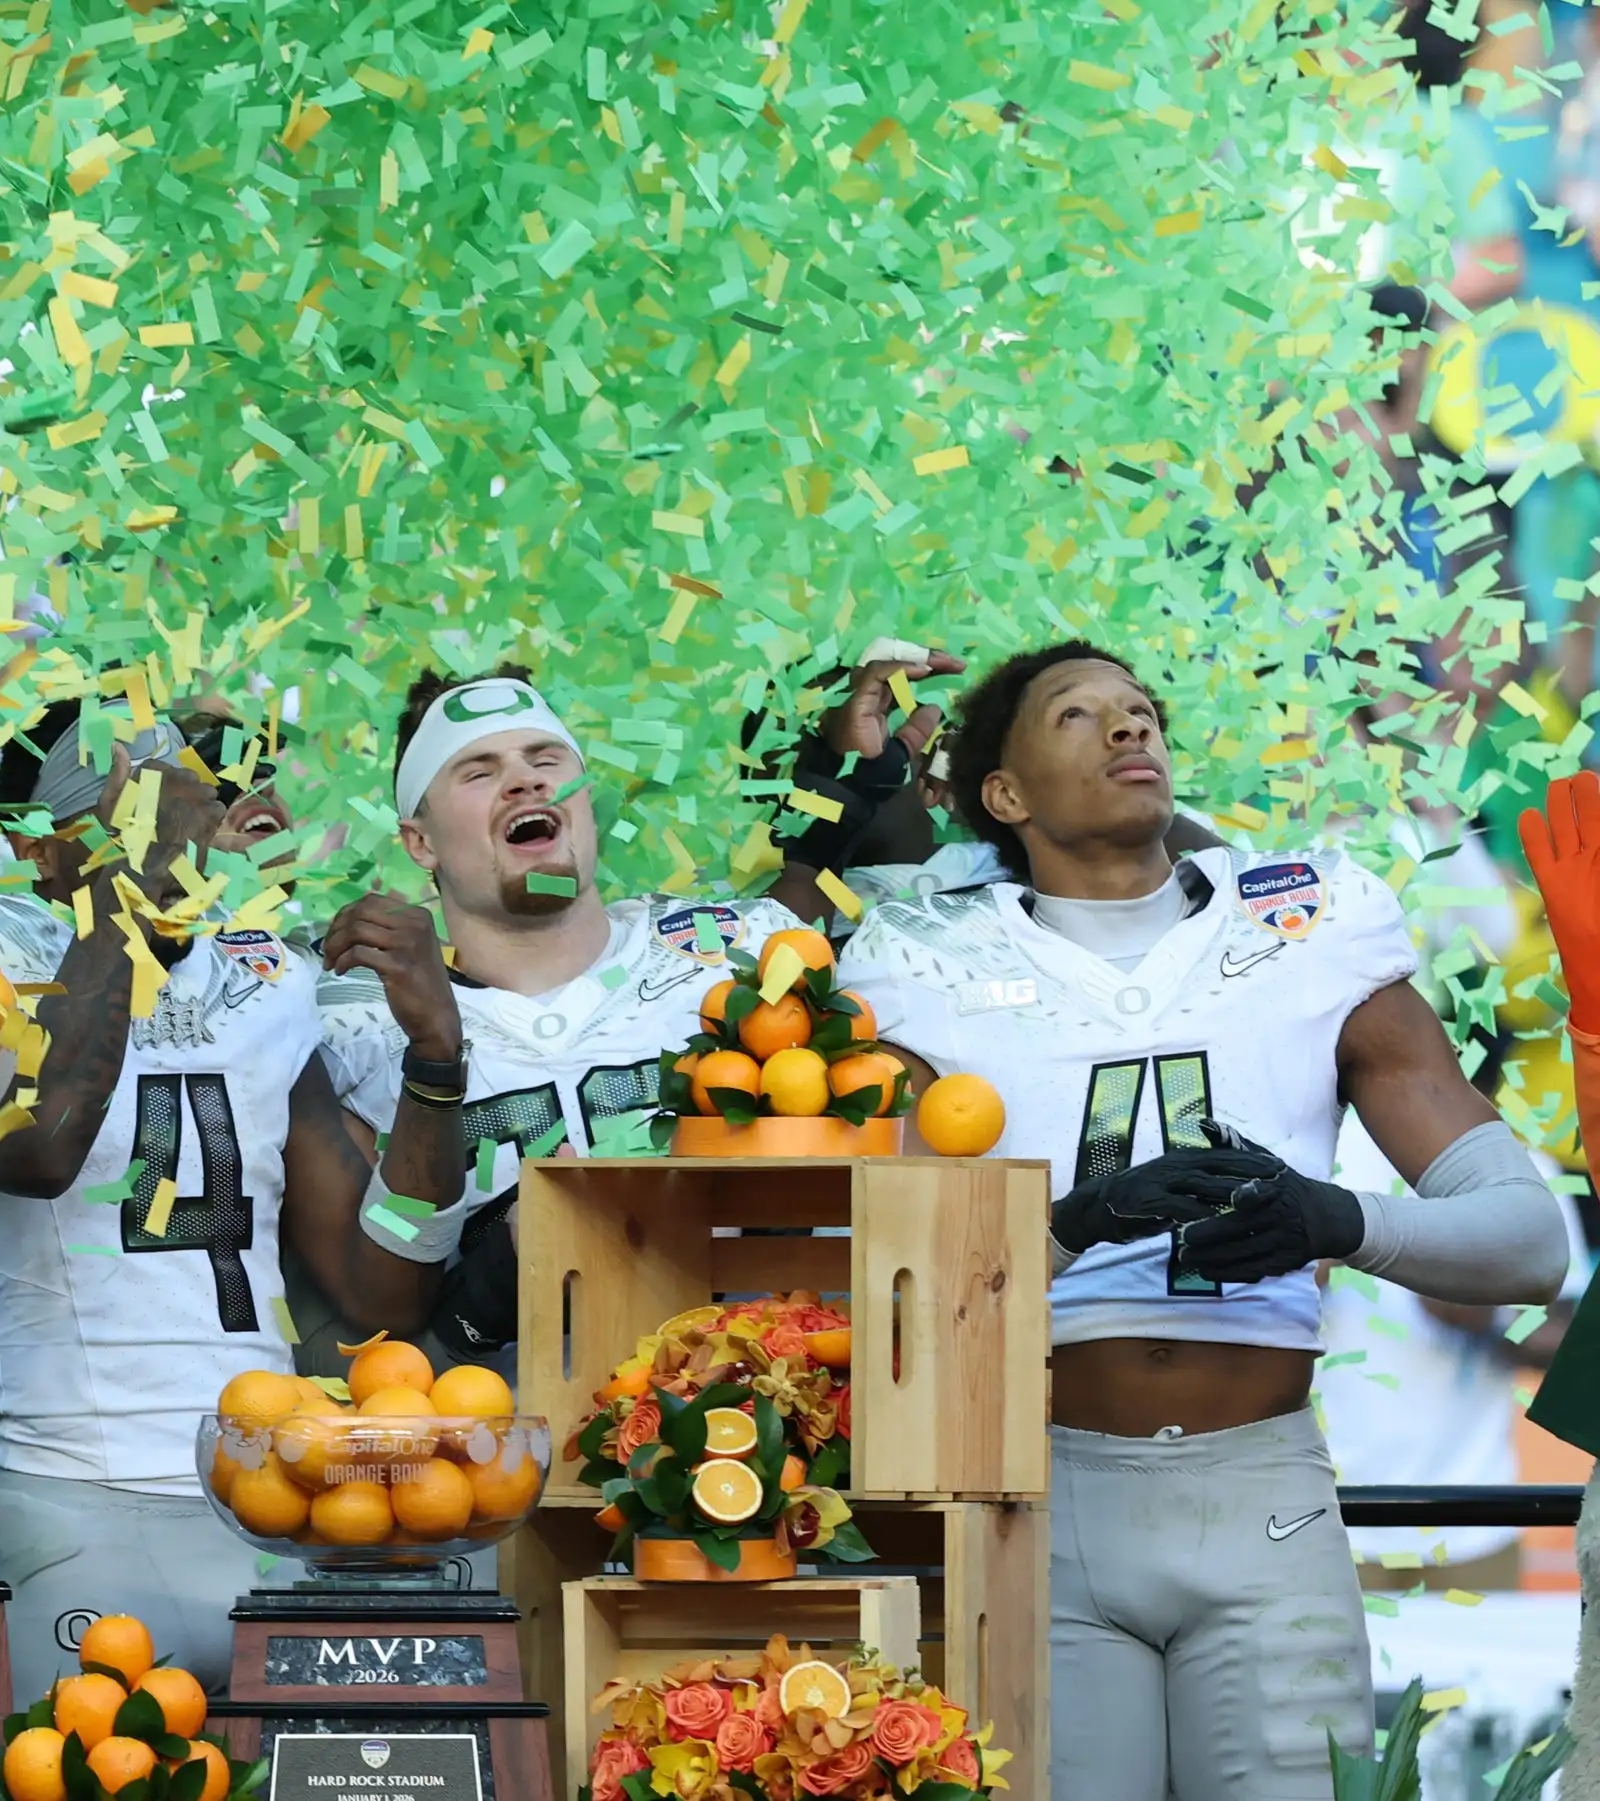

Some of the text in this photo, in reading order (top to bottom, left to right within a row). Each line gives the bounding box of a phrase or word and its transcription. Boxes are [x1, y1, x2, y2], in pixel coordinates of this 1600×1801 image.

[443, 686, 534, 723] O
[122, 1073, 259, 1332] 4
[325, 1463, 386, 1484] ORANGE
[316, 1638, 437, 1665] MVP
[354, 1669, 399, 1683] 2026
[308, 1775, 445, 1787] HARD ROCK STADIUM
